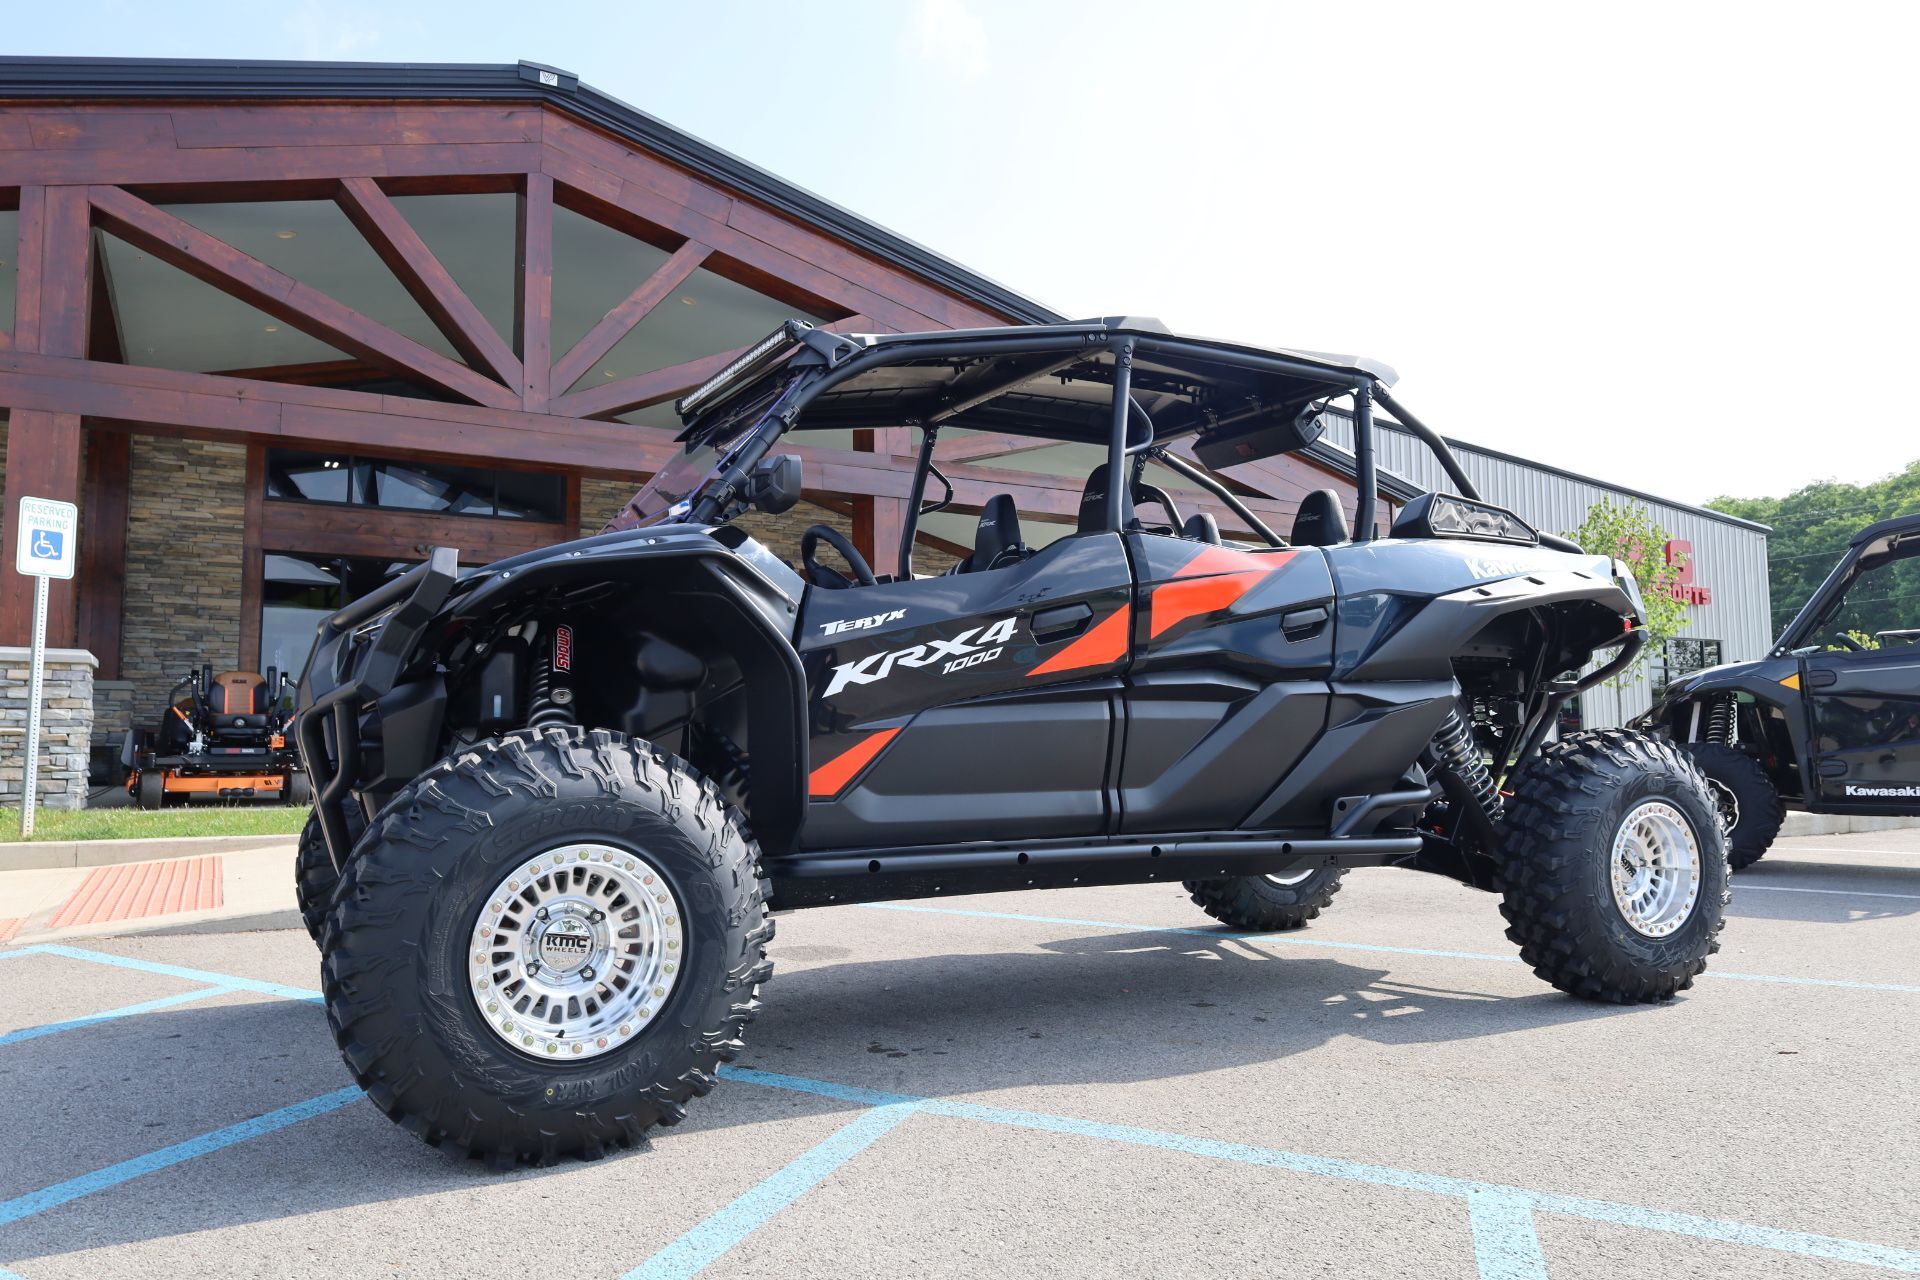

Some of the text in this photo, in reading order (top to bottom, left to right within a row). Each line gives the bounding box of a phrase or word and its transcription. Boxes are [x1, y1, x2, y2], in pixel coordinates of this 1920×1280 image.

[24, 502, 73, 518] RESERVED
[28, 515, 68, 529] PARKING
[820, 608, 907, 636] TERYX
[556, 627, 570, 671] SHOWA
[942, 646, 1004, 675] 1000
[1845, 785, 1920, 797] Kawasaki
[546, 934, 589, 948] KMC
